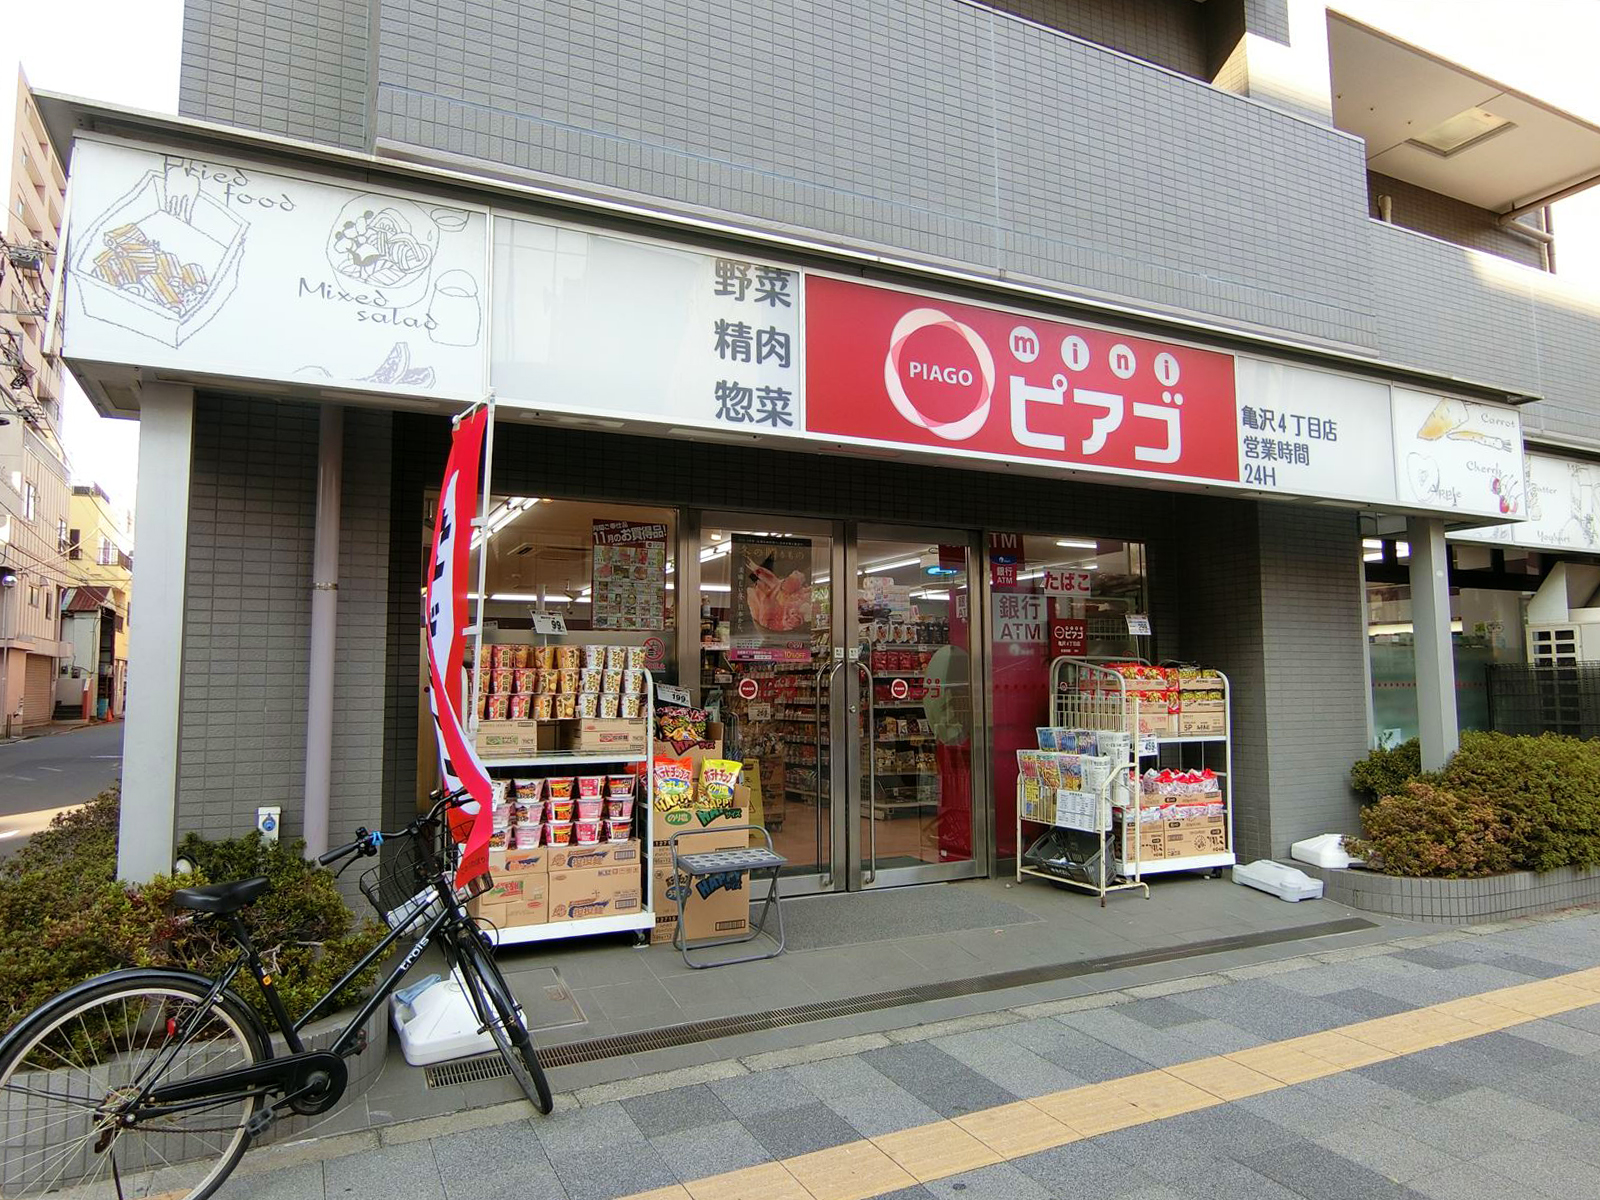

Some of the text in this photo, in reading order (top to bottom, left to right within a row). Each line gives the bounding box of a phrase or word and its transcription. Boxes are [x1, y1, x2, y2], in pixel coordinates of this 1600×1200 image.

[224, 182, 296, 212] food
[298, 276, 388, 307] Mixed
[714, 259, 792, 308] 野菜
[356, 306, 439, 331] salad
[714, 318, 791, 369] 精肉
[1011, 329, 1174, 383] mini
[909, 361, 973, 387] PIAGO
[714, 379, 793, 427] 惣菜
[1008, 373, 1184, 464] ピアゴ
[1241, 404, 1337, 442] 亀沢4丁目店
[1481, 412, 1515, 428] Carrot
[1243, 435, 1310, 466] 営業時間
[1244, 463, 1276, 486] 24H
[989, 532, 1018, 549] TM
[996, 566, 1013, 576] 銀行
[996, 576, 1013, 585] ATM
[1044, 571, 1090, 592] たばこ
[999, 595, 1041, 620] 銀行
[551, 620, 562, 630] 99
[1000, 623, 1041, 641] ATM
[672, 693, 686, 703] 199
[654, 793, 692, 812] HAPPY
